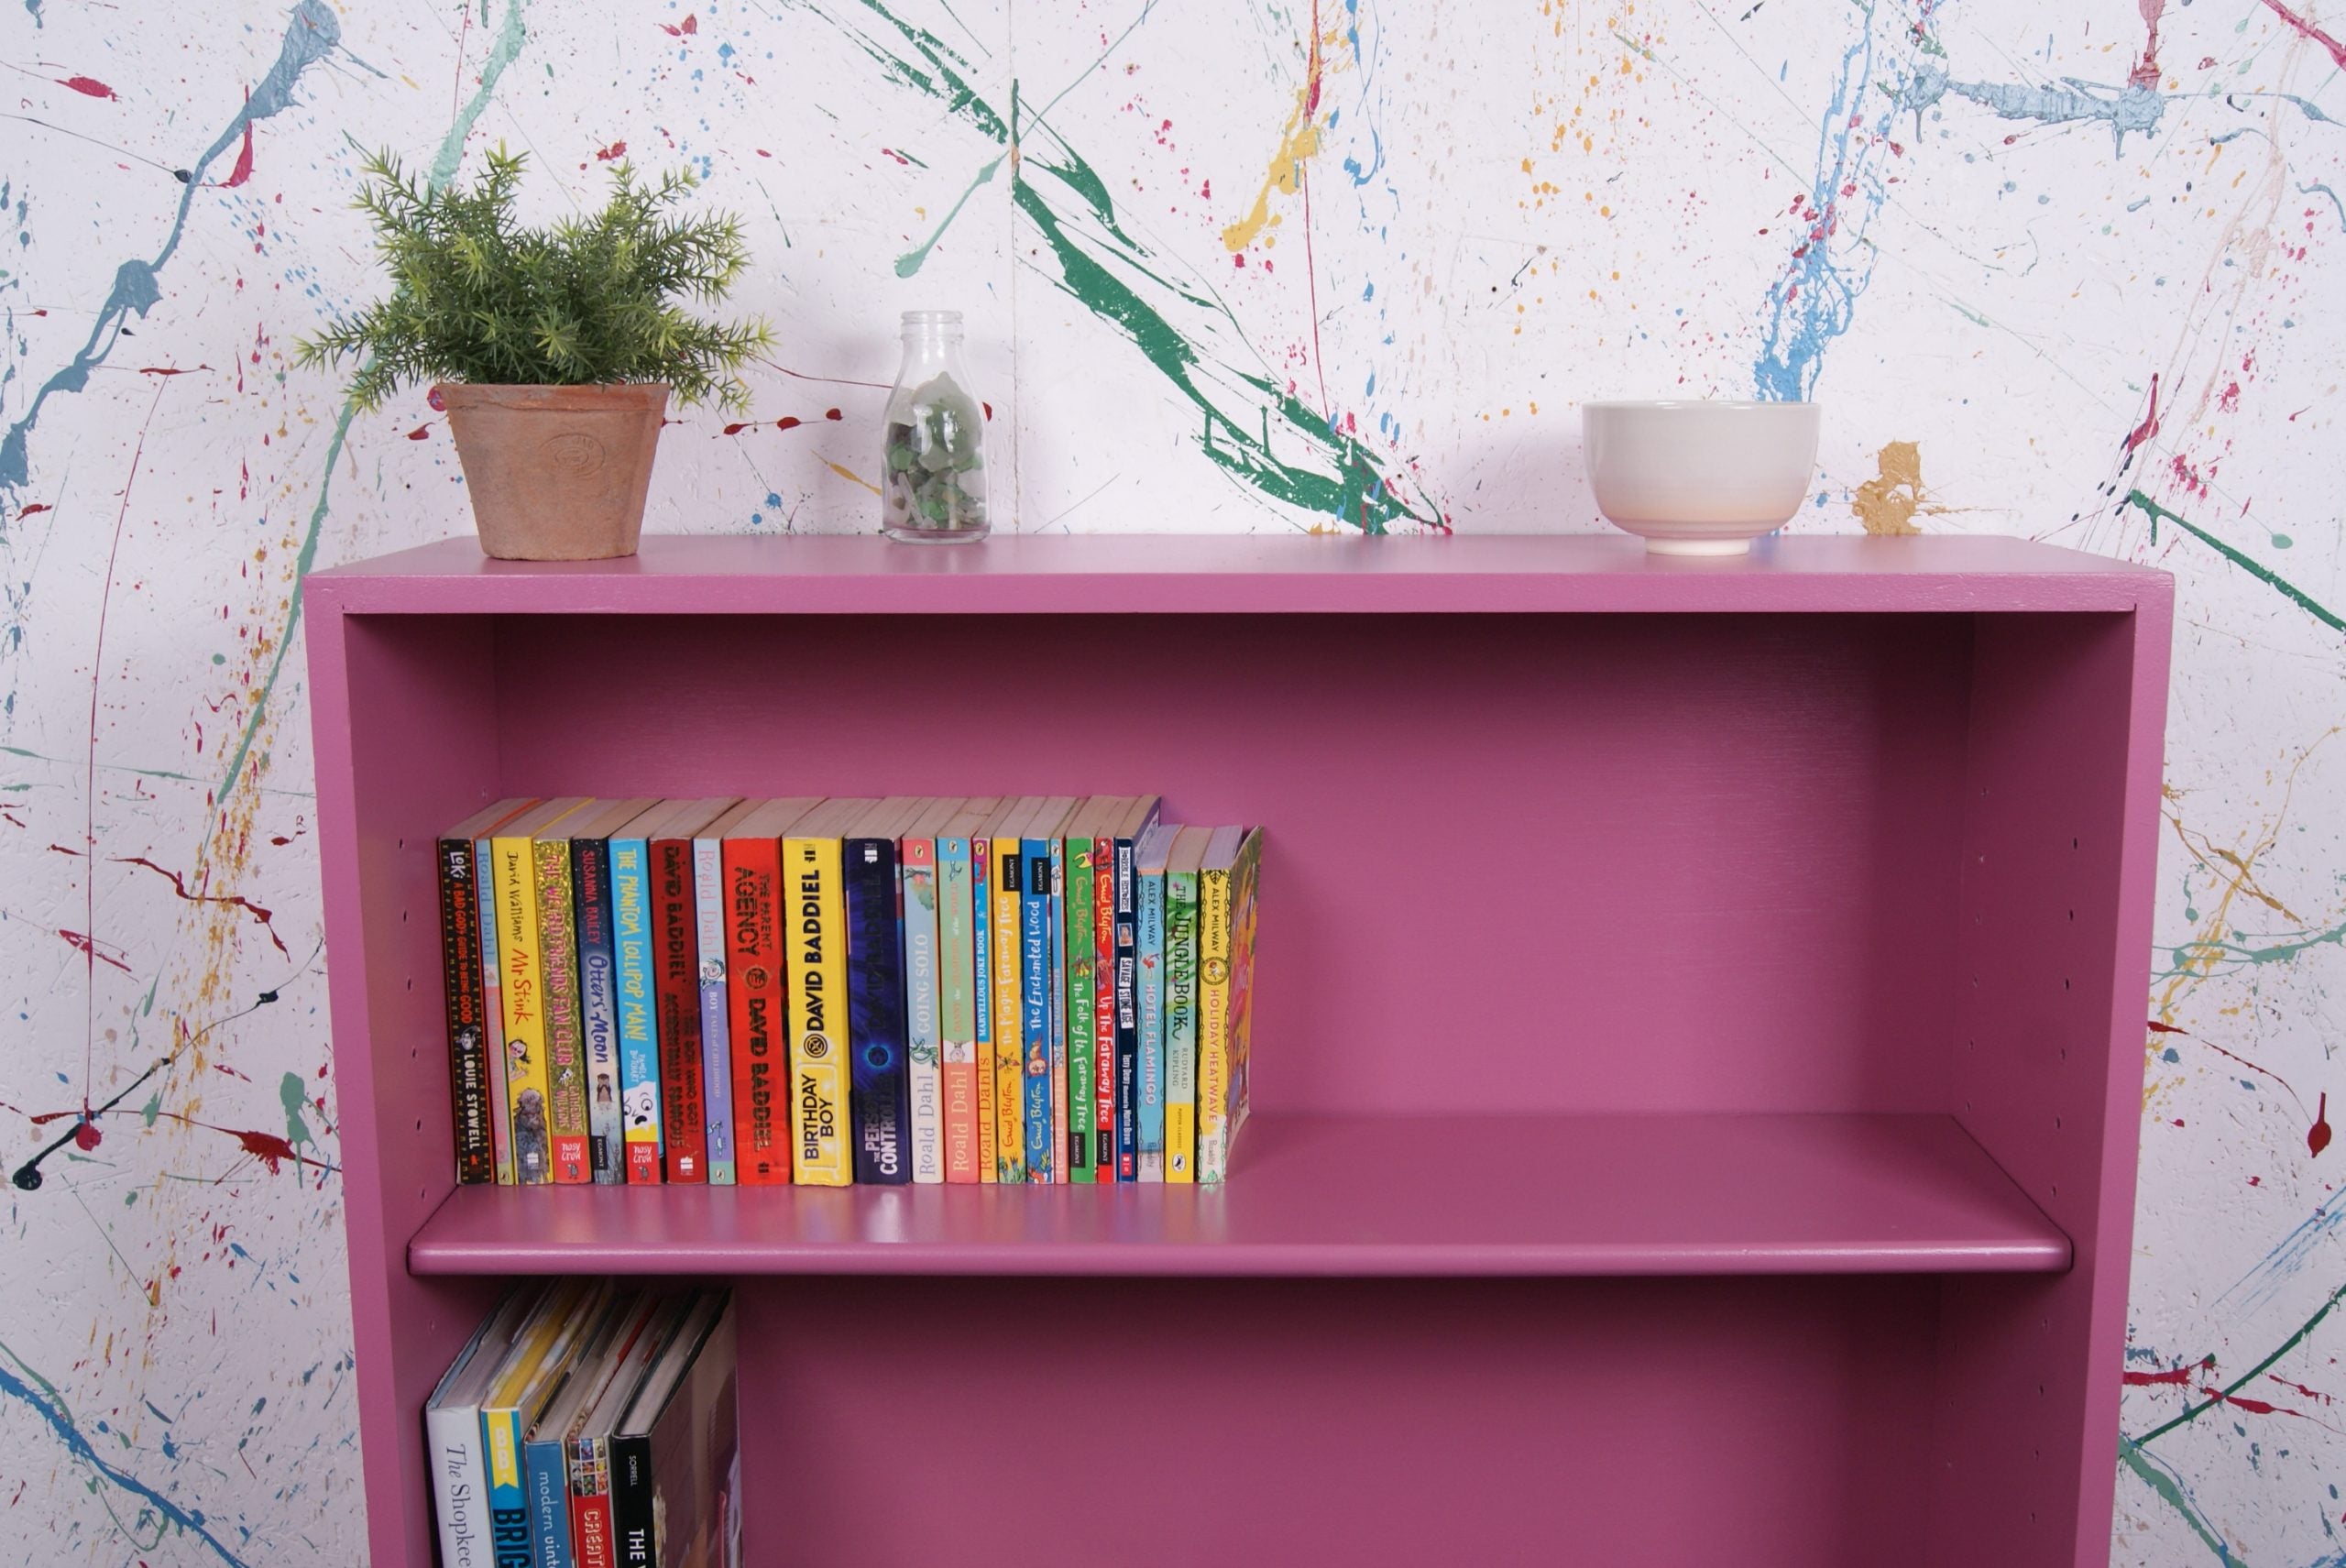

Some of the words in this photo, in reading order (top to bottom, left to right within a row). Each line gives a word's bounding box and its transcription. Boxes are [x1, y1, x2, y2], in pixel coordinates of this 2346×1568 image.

[477, 852, 492, 902] Roald
[507, 850, 521, 886] David
[543, 855, 562, 880] THE
[582, 850, 598, 904] SUSANNA
[617, 848, 637, 871] THE
[663, 846, 682, 897] DAVID
[698, 850, 717, 900] Roald
[454, 891, 466, 909] BAD
[759, 873, 771, 897] THE
[950, 882, 959, 916] WORLD
[1076, 875, 1088, 905] Enid
[1100, 874, 1113, 905] Enid
[1147, 881, 1157, 905] ALEX
[1176, 886, 1187, 909] THE
[1211, 888, 1220, 911] ALEX
[509, 889, 524, 942] Walliams
[545, 885, 565, 936] WEIRD
[618, 874, 642, 936] PHANTOM
[734, 866, 761, 957] AGENCY
[802, 870, 823, 963] BADDIEL
[997, 896, 1013, 925] Tree
[1027, 901, 1041, 936] Wood
[482, 913, 496, 955] Dahl
[585, 905, 601, 945] BAILEY
[666, 902, 685, 980] BADDIEL
[701, 911, 719, 954] Dahl
[761, 902, 773, 950] PARENT
[977, 929, 985, 954] BOOK
[1076, 908, 1089, 944] Blyton
[1099, 906, 1113, 944] Blyton
[1147, 909, 1157, 946] MILWAY
[1211, 915, 1220, 952] MILWAY
[456, 937, 468, 960] GUIDE
[510, 948, 529, 976] Mr
[915, 934, 929, 977] SOLO
[997, 929, 1014, 985] Faraway
[1174, 909, 1191, 981] JUNGLE
[460, 971, 470, 992] BEING
[549, 937, 569, 994] FRIENDS
[622, 940, 645, 999] LOLLIPOP
[977, 954, 985, 978] JOKE
[1027, 939, 1043, 1007] Enchanted
[1121, 959, 1132, 983] SAVAGE
[460, 994, 473, 1024] GOOD
[513, 979, 534, 1025] Stink
[709, 992, 718, 1010] BOY
[805, 970, 825, 1032] DAVID
[916, 981, 931, 1034] GOING
[977, 978, 986, 1037] MARVELLOUS
[1000, 986, 1014, 1026] Magic
[1074, 982, 1084, 998] The
[1098, 996, 1113, 1009] Up
[1120, 991, 1131, 1010] STONE
[1145, 984, 1157, 1029] HOTEL
[553, 996, 573, 1025] FAN
[624, 1002, 649, 1041] MAN!
[710, 1014, 718, 1038] TALES
[749, 998, 768, 1057] DAVID
[952, 1002, 961, 1033] DANNY
[1030, 1007, 1042, 1031] The
[1076, 999, 1089, 1023] Folk
[1100, 1013, 1112, 1033] The
[1122, 1012, 1132, 1024] AGE
[1172, 983, 1190, 1039] BOOK
[1209, 990, 1220, 1048] HOLIDAY
[554, 1027, 575, 1066] CLUB
[589, 1012, 609, 1063] Moon
[664, 992, 682, 1082] ACCIDENTALLY
[1002, 1029, 1014, 1045] The
[1072, 1025, 1087, 1036] of
[1074, 1037, 1088, 1054] the
[464, 1054, 477, 1090] LOUIE
[712, 1048, 722, 1099] CHILDHOOD
[1073, 1056, 1089, 1101] Faraway
[1099, 1036, 1113, 1093] Faraway
[1123, 1054, 1132, 1068] Terry
[1123, 1069, 1132, 1084] Deary
[1145, 1031, 1157, 1105] FLAMINGO
[685, 1069, 697, 1100] WHO
[917, 1075, 934, 1117] Dahl
[950, 1070, 968, 1113] Dahl
[1002, 1080, 1014, 1119] Blyton
[1030, 1082, 1045, 1121] Blyton
[1208, 1054, 1219, 1122] HEATWAVE
[466, 1093, 480, 1150] STOWELL
[568, 1085, 582, 1132] CATHERINE
[669, 1086, 685, 1148] FAMOUS
[751, 1063, 772, 1152] BADDIEL
[801, 1073, 819, 1160] BIRTHDAY
[819, 1098, 834, 1137] BOY
[1075, 1102, 1089, 1131] Tree
[1099, 1096, 1113, 1124] Tree
[1123, 1109, 1132, 1127] Martin
[919, 1127, 936, 1176] Roald
[951, 1123, 969, 1172] Roald
[981, 1121, 992, 1171] Roald
[1003, 1119, 1014, 1147] Enid
[1031, 1123, 1043, 1149] Enid
[1124, 1128, 1133, 1145] Brown
[446, 1443, 467, 1478] The
[629, 1455, 638, 1486] SORRELL
[539, 1472, 559, 1531] modern
[544, 1536, 561, 1568] vint
[584, 1508, 606, 1568] CREAT
[629, 1529, 645, 1560] THE
